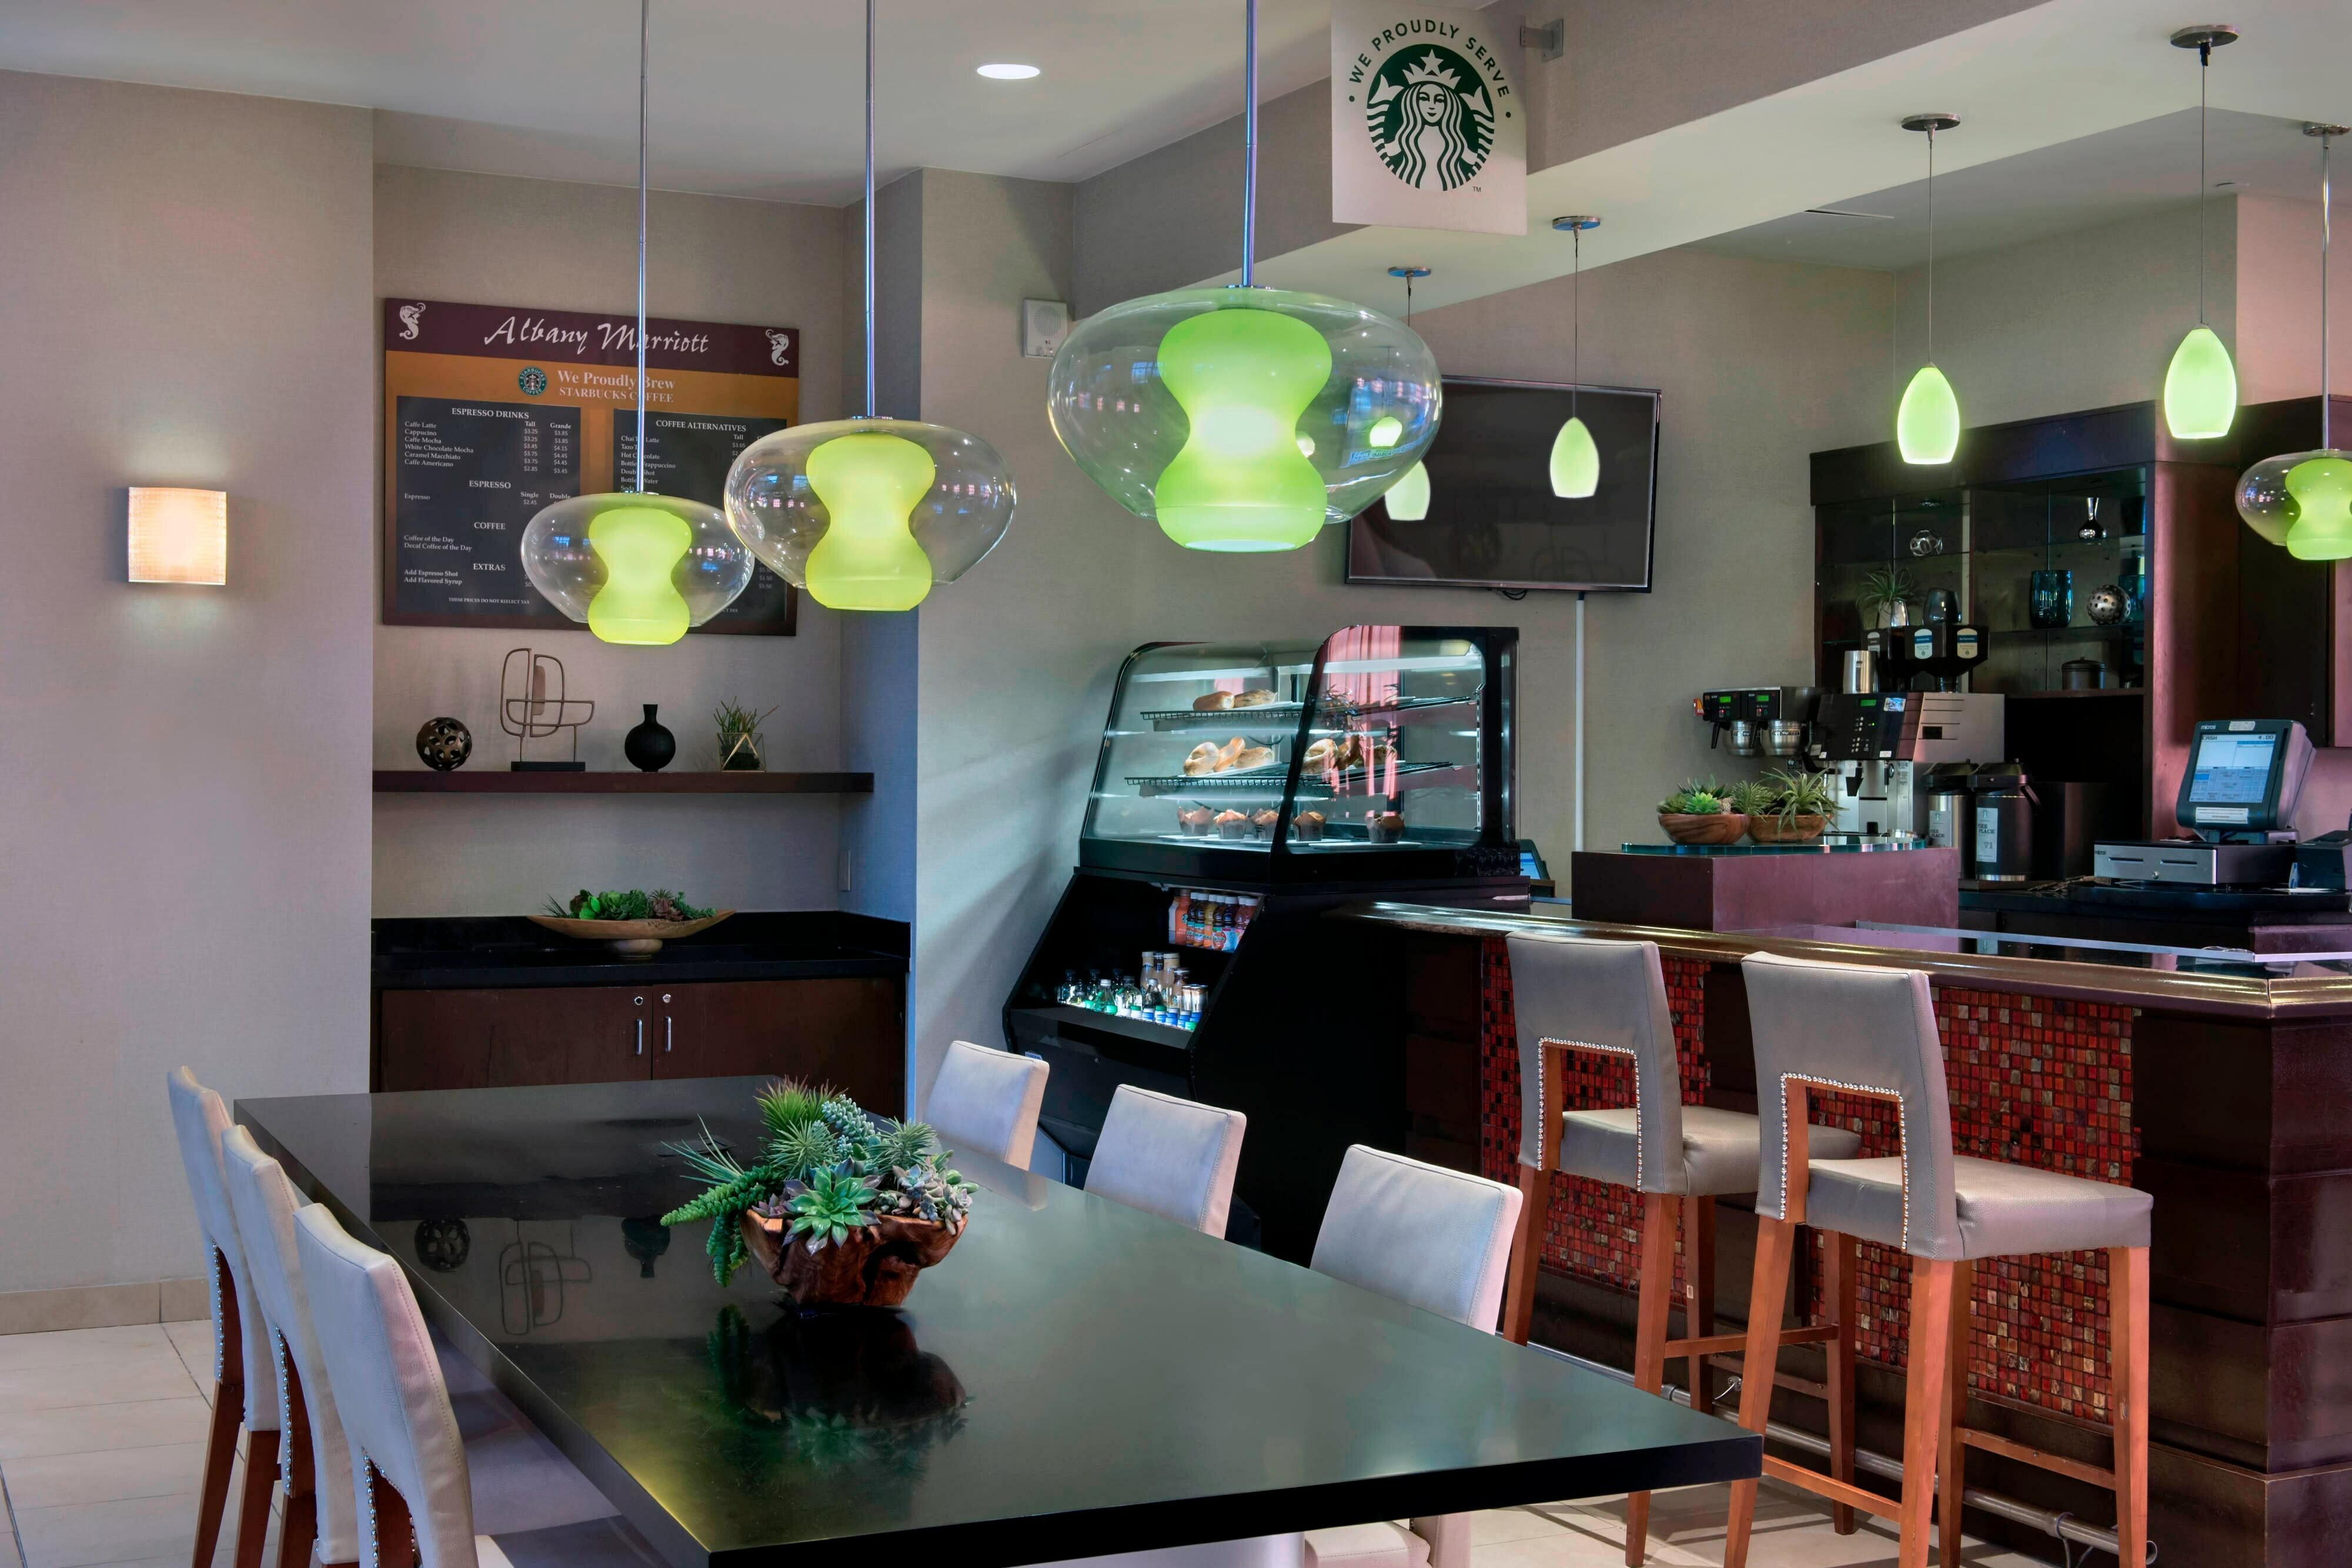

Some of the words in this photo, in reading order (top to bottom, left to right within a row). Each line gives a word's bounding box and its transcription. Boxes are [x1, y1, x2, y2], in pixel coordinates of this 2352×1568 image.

[1349, 53, 1372, 84] WE
[1372, 19, 1459, 51] PROUDLY
[1465, 37, 1510, 98] SERVE
[484, 316, 588, 355] Albany
[557, 370, 579, 385] We
[583, 373, 637, 390] Proudly
[559, 387, 626, 400] STARBUCKS
[630, 392, 673, 403] CFFEE
[452, 407, 493, 417] ESPRESSO
[496, 410, 529, 419] DRINKS
[656, 420, 686, 429] COFFEE
[687, 422, 747, 432] ALTERNATIVES
[469, 480, 511, 489] ESPRESSO
[474, 521, 506, 530] COFFEE
[473, 563, 506, 571] EXTRAS
